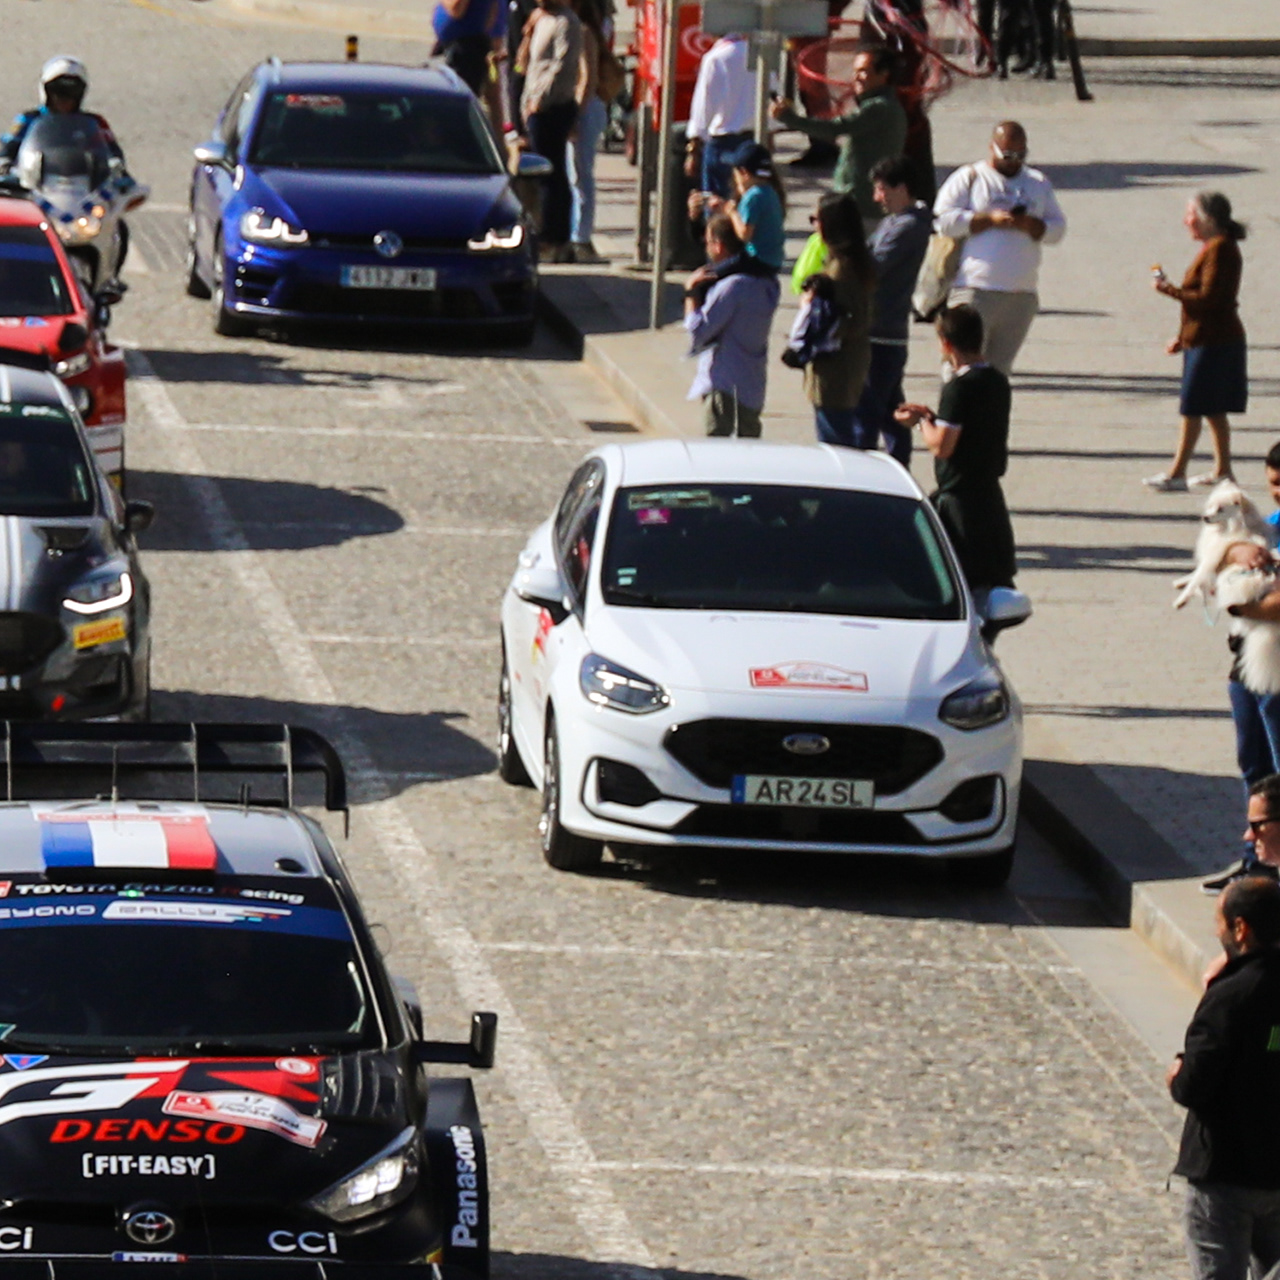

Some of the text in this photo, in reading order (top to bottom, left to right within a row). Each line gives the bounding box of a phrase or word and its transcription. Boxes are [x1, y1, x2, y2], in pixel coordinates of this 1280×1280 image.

[16, 884, 115, 895] TOYOTA
[119, 906, 216, 916] RALLY
[50, 1118, 246, 1145] DENSO
[445, 1125, 478, 1248] Panasonic
